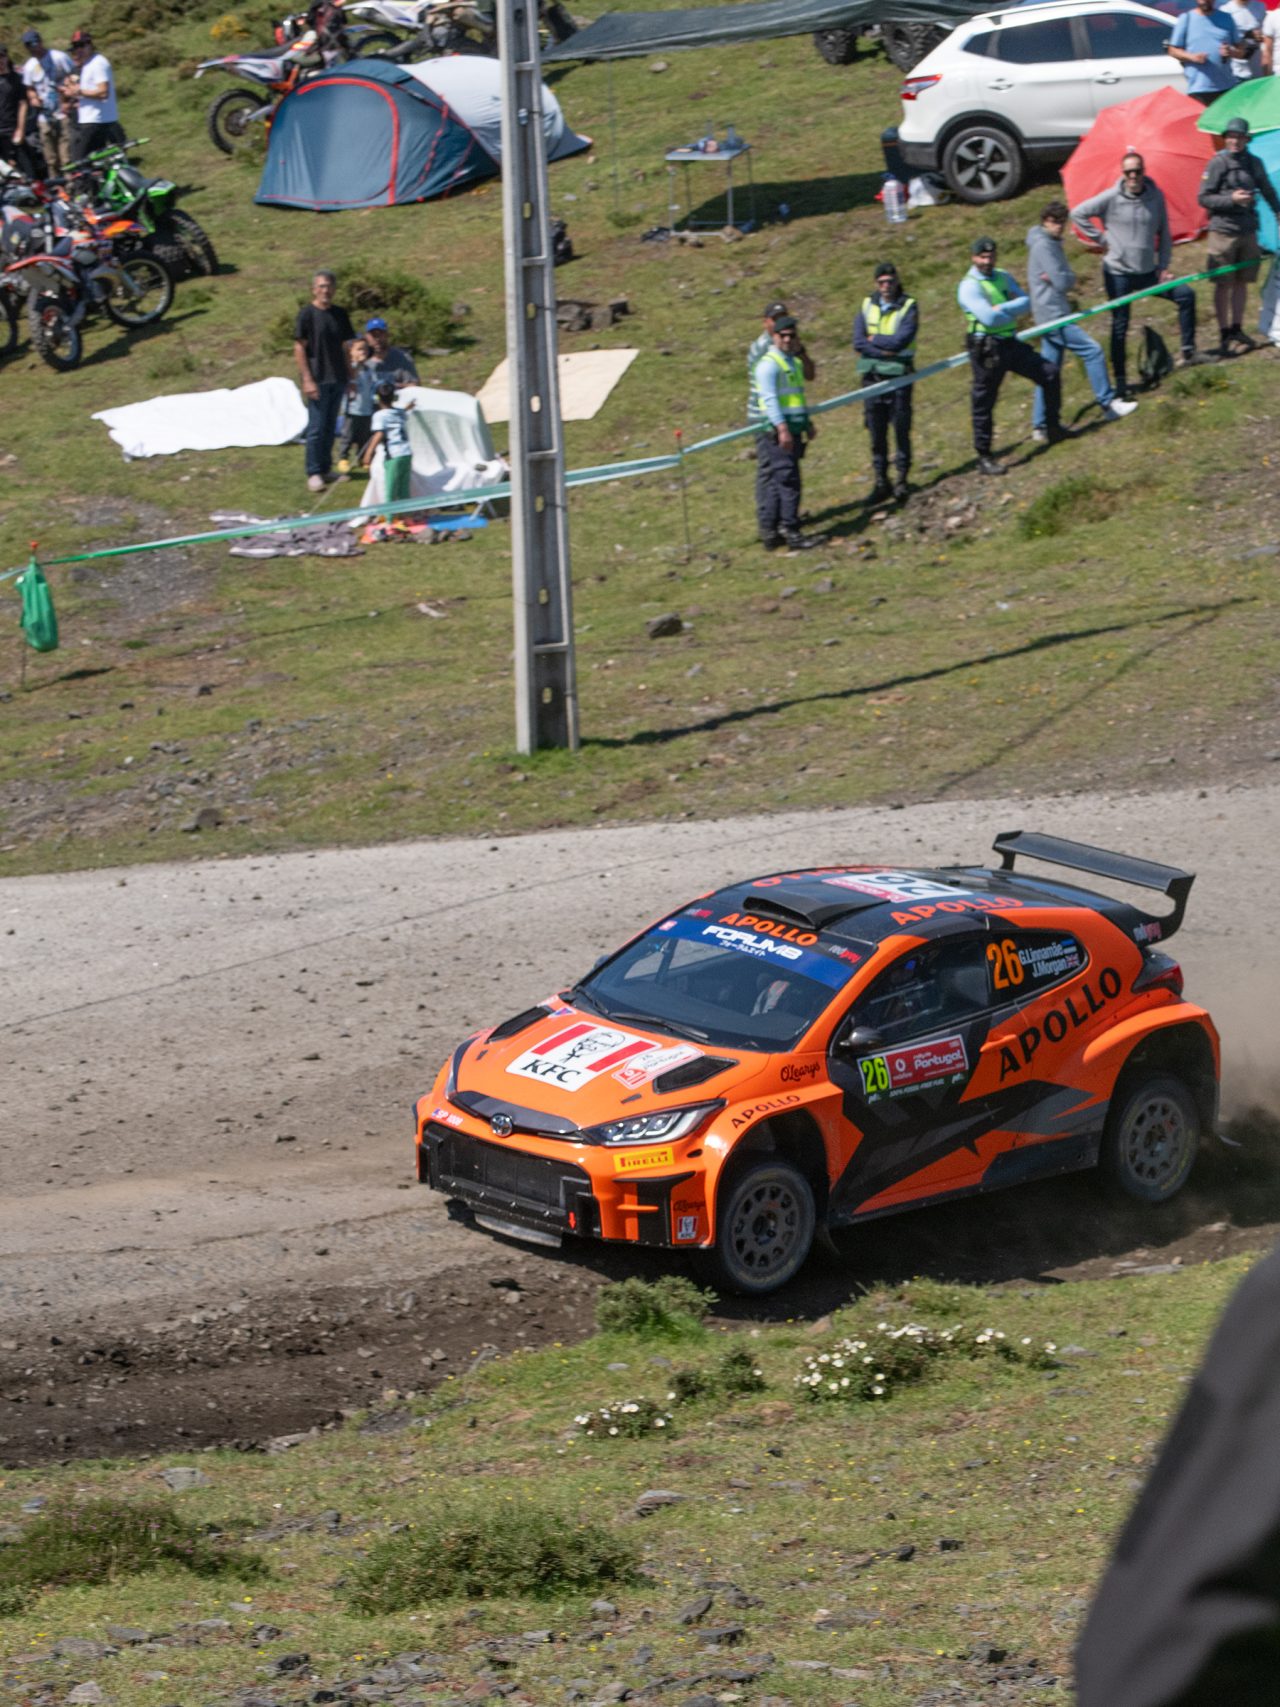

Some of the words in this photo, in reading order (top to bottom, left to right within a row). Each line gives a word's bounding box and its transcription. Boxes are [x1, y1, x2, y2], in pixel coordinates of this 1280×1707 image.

[890, 897, 1024, 926] APOLLO
[718, 912, 818, 946] APOLLO
[986, 938, 1025, 990] 26
[1000, 966, 1121, 1082] APOLLO
[522, 1058, 581, 1084] KFC
[862, 1057, 889, 1093] 26
[731, 1094, 801, 1129] APOLLO
[619, 1151, 669, 1168] PIRELLI
